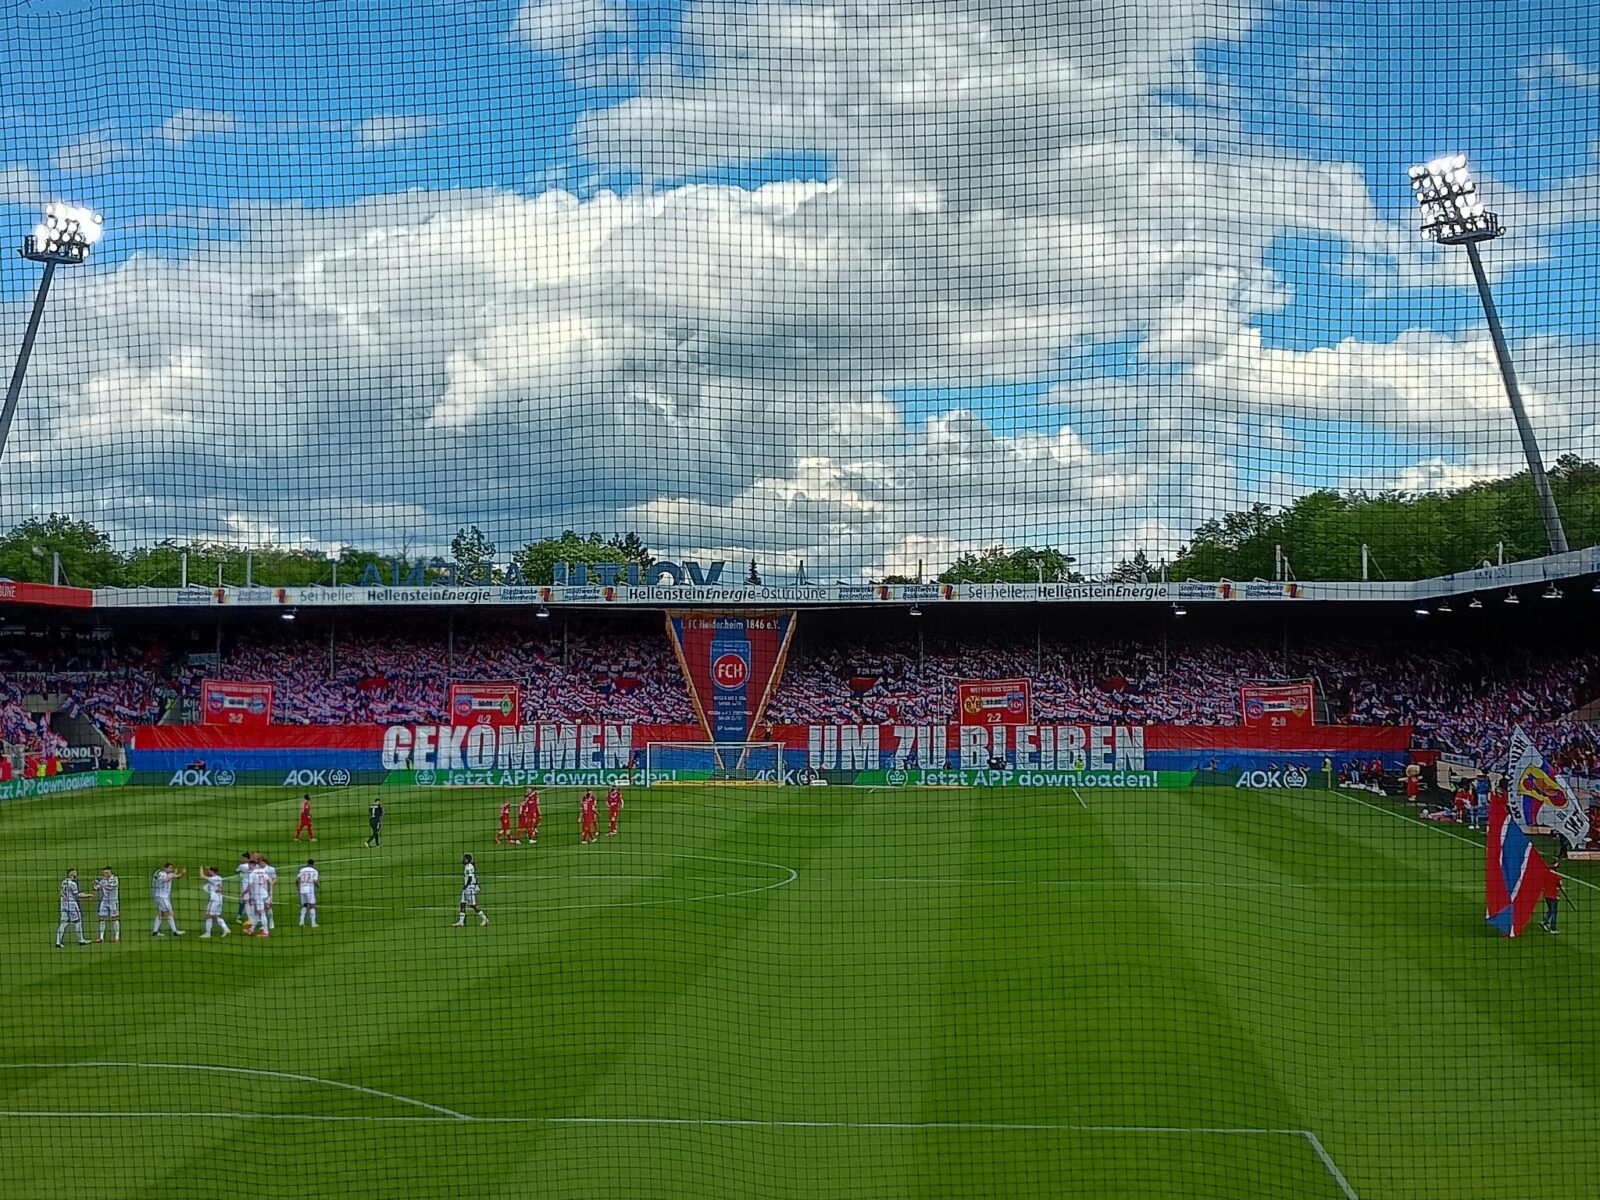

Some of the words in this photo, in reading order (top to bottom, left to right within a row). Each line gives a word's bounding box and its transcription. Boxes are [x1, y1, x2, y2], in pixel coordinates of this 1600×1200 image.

[367, 588, 490, 603] HellensteinEnergie
[1038, 585, 1166, 600] HellensteinEnergie
[746, 619, 765, 630] 1846
[718, 664, 743, 678] FCH
[381, 724, 633, 770] GEKOMMEN
[808, 724, 880, 770] UM
[892, 724, 947, 770] ZU
[959, 724, 1145, 770] BLEIBEN
[169, 770, 212, 786] AOK
[283, 770, 328, 786] AOK
[443, 771, 494, 786] Jetzt
[499, 771, 538, 786] APP
[914, 770, 968, 786] Jetzt
[972, 770, 1013, 786] APP
[1018, 770, 1159, 786] downloaden!
[1235, 770, 1283, 788] AOK
